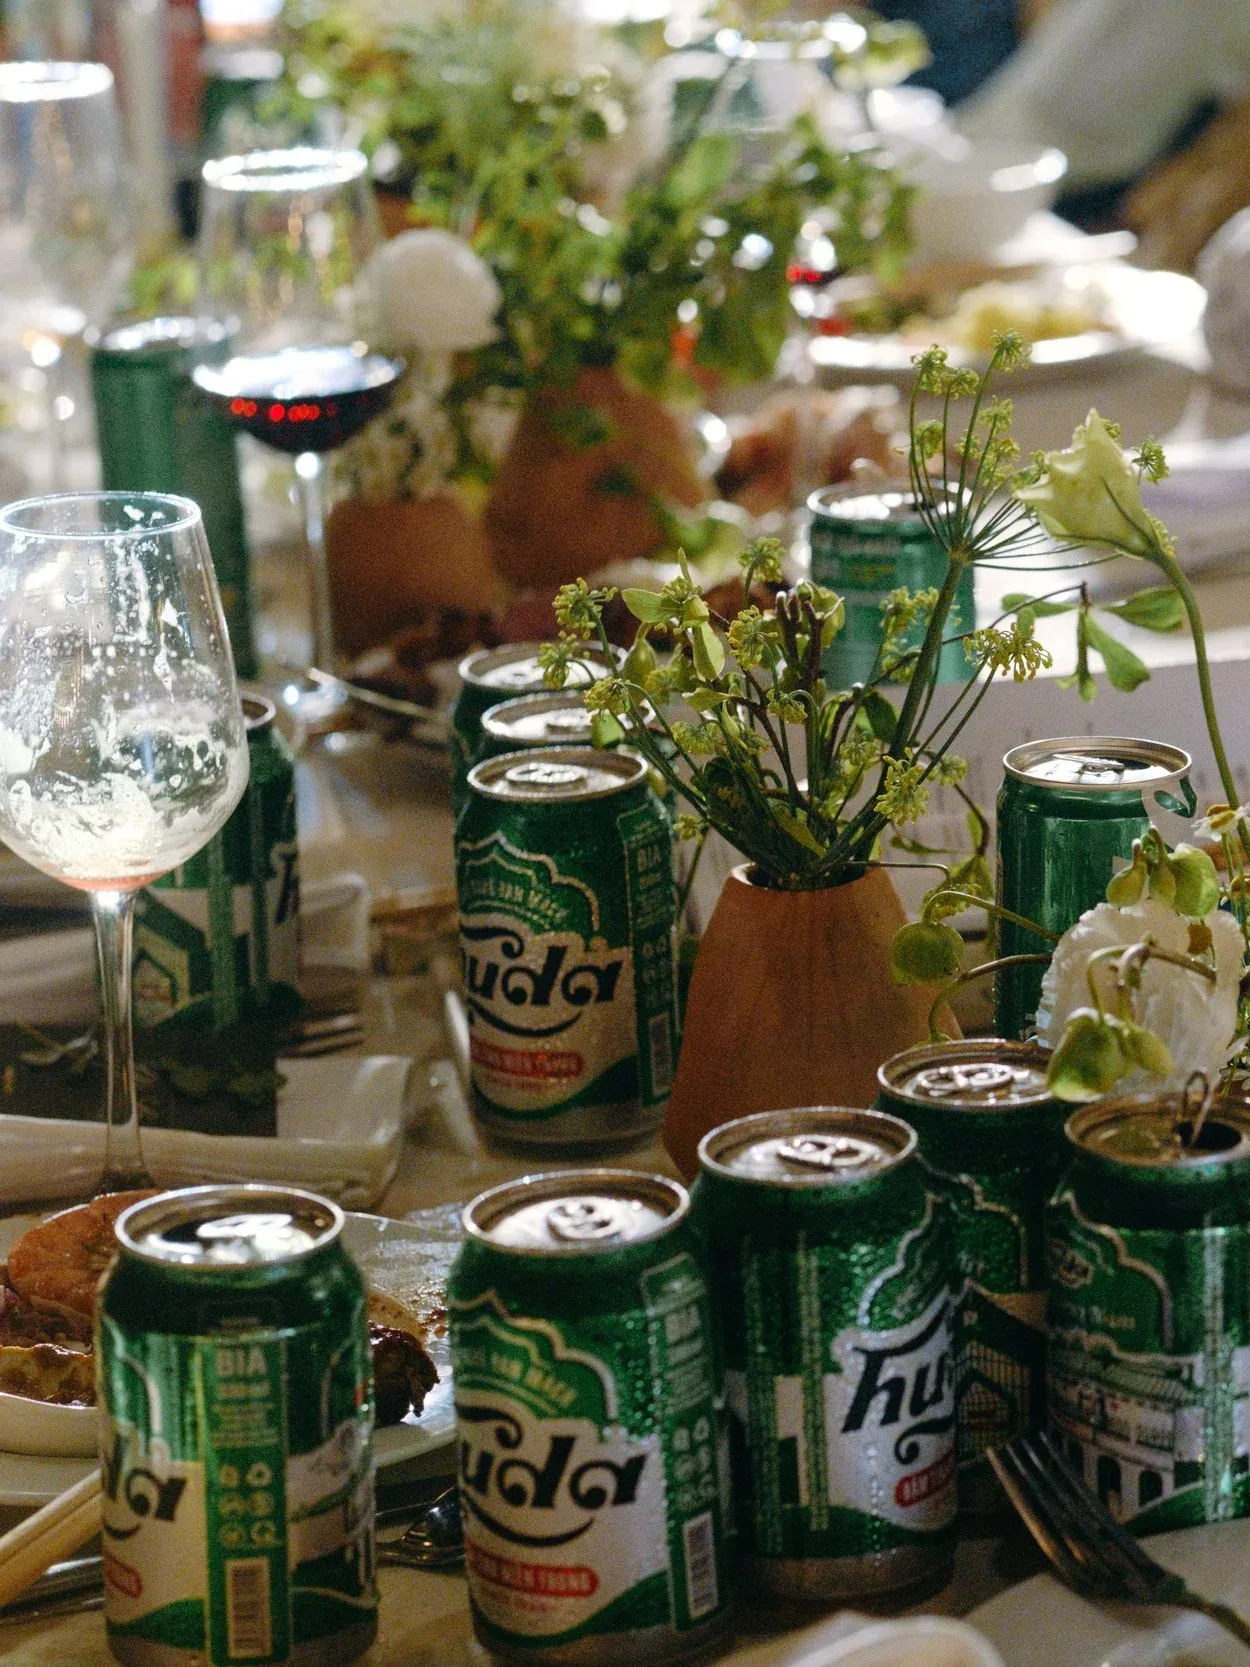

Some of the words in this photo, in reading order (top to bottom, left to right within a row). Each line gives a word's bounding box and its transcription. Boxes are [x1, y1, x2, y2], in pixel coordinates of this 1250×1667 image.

[460, 924, 625, 1008] uda
[216, 1350, 268, 1378] BIA
[457, 1404, 648, 1510] uda
